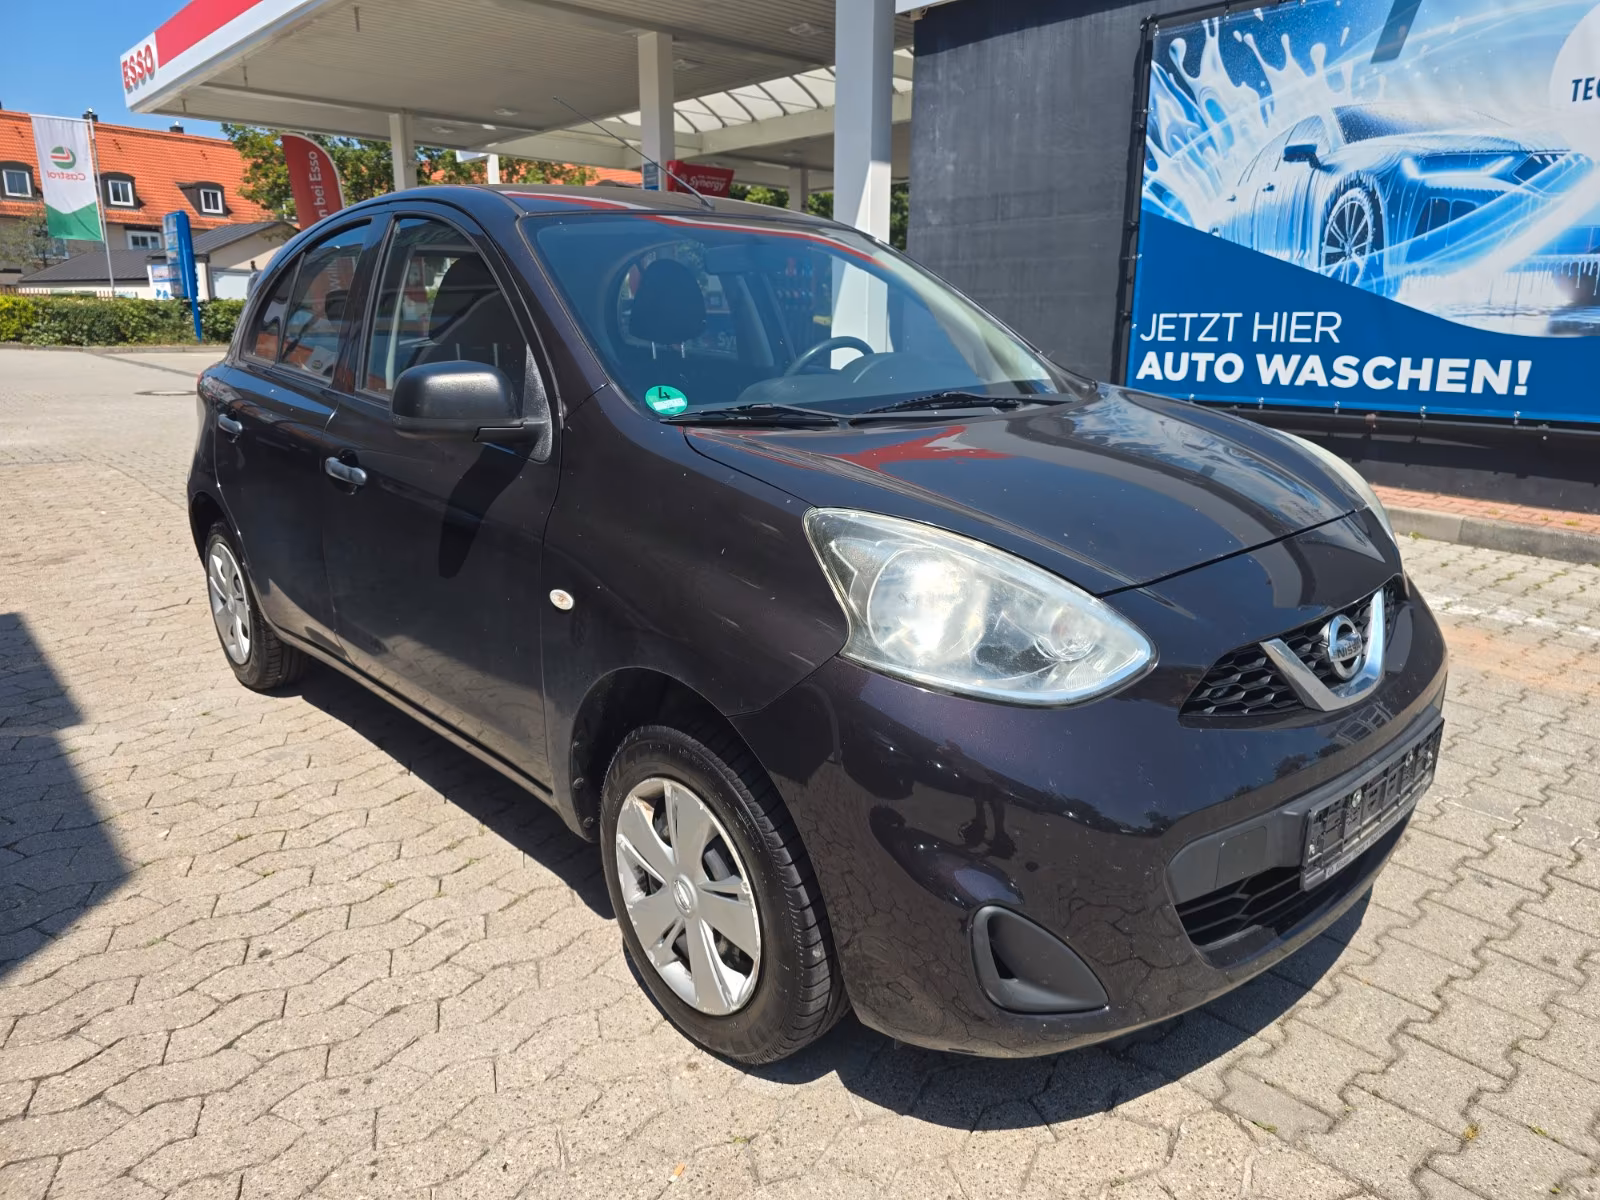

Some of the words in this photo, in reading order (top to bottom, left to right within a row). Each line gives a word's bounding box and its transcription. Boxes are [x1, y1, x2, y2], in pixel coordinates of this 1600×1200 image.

[122, 45, 154, 89] ESSO
[1572, 76, 1600, 102] TE
[308, 151, 322, 182] Esso
[310, 185, 327, 205] bei
[689, 174, 727, 192] Synergy
[1139, 312, 1243, 342] JETZT
[1252, 311, 1342, 344] HIER
[1135, 351, 1245, 384] AUTO
[1255, 353, 1532, 396] WASCHEN!
[658, 387, 671, 399] 4
